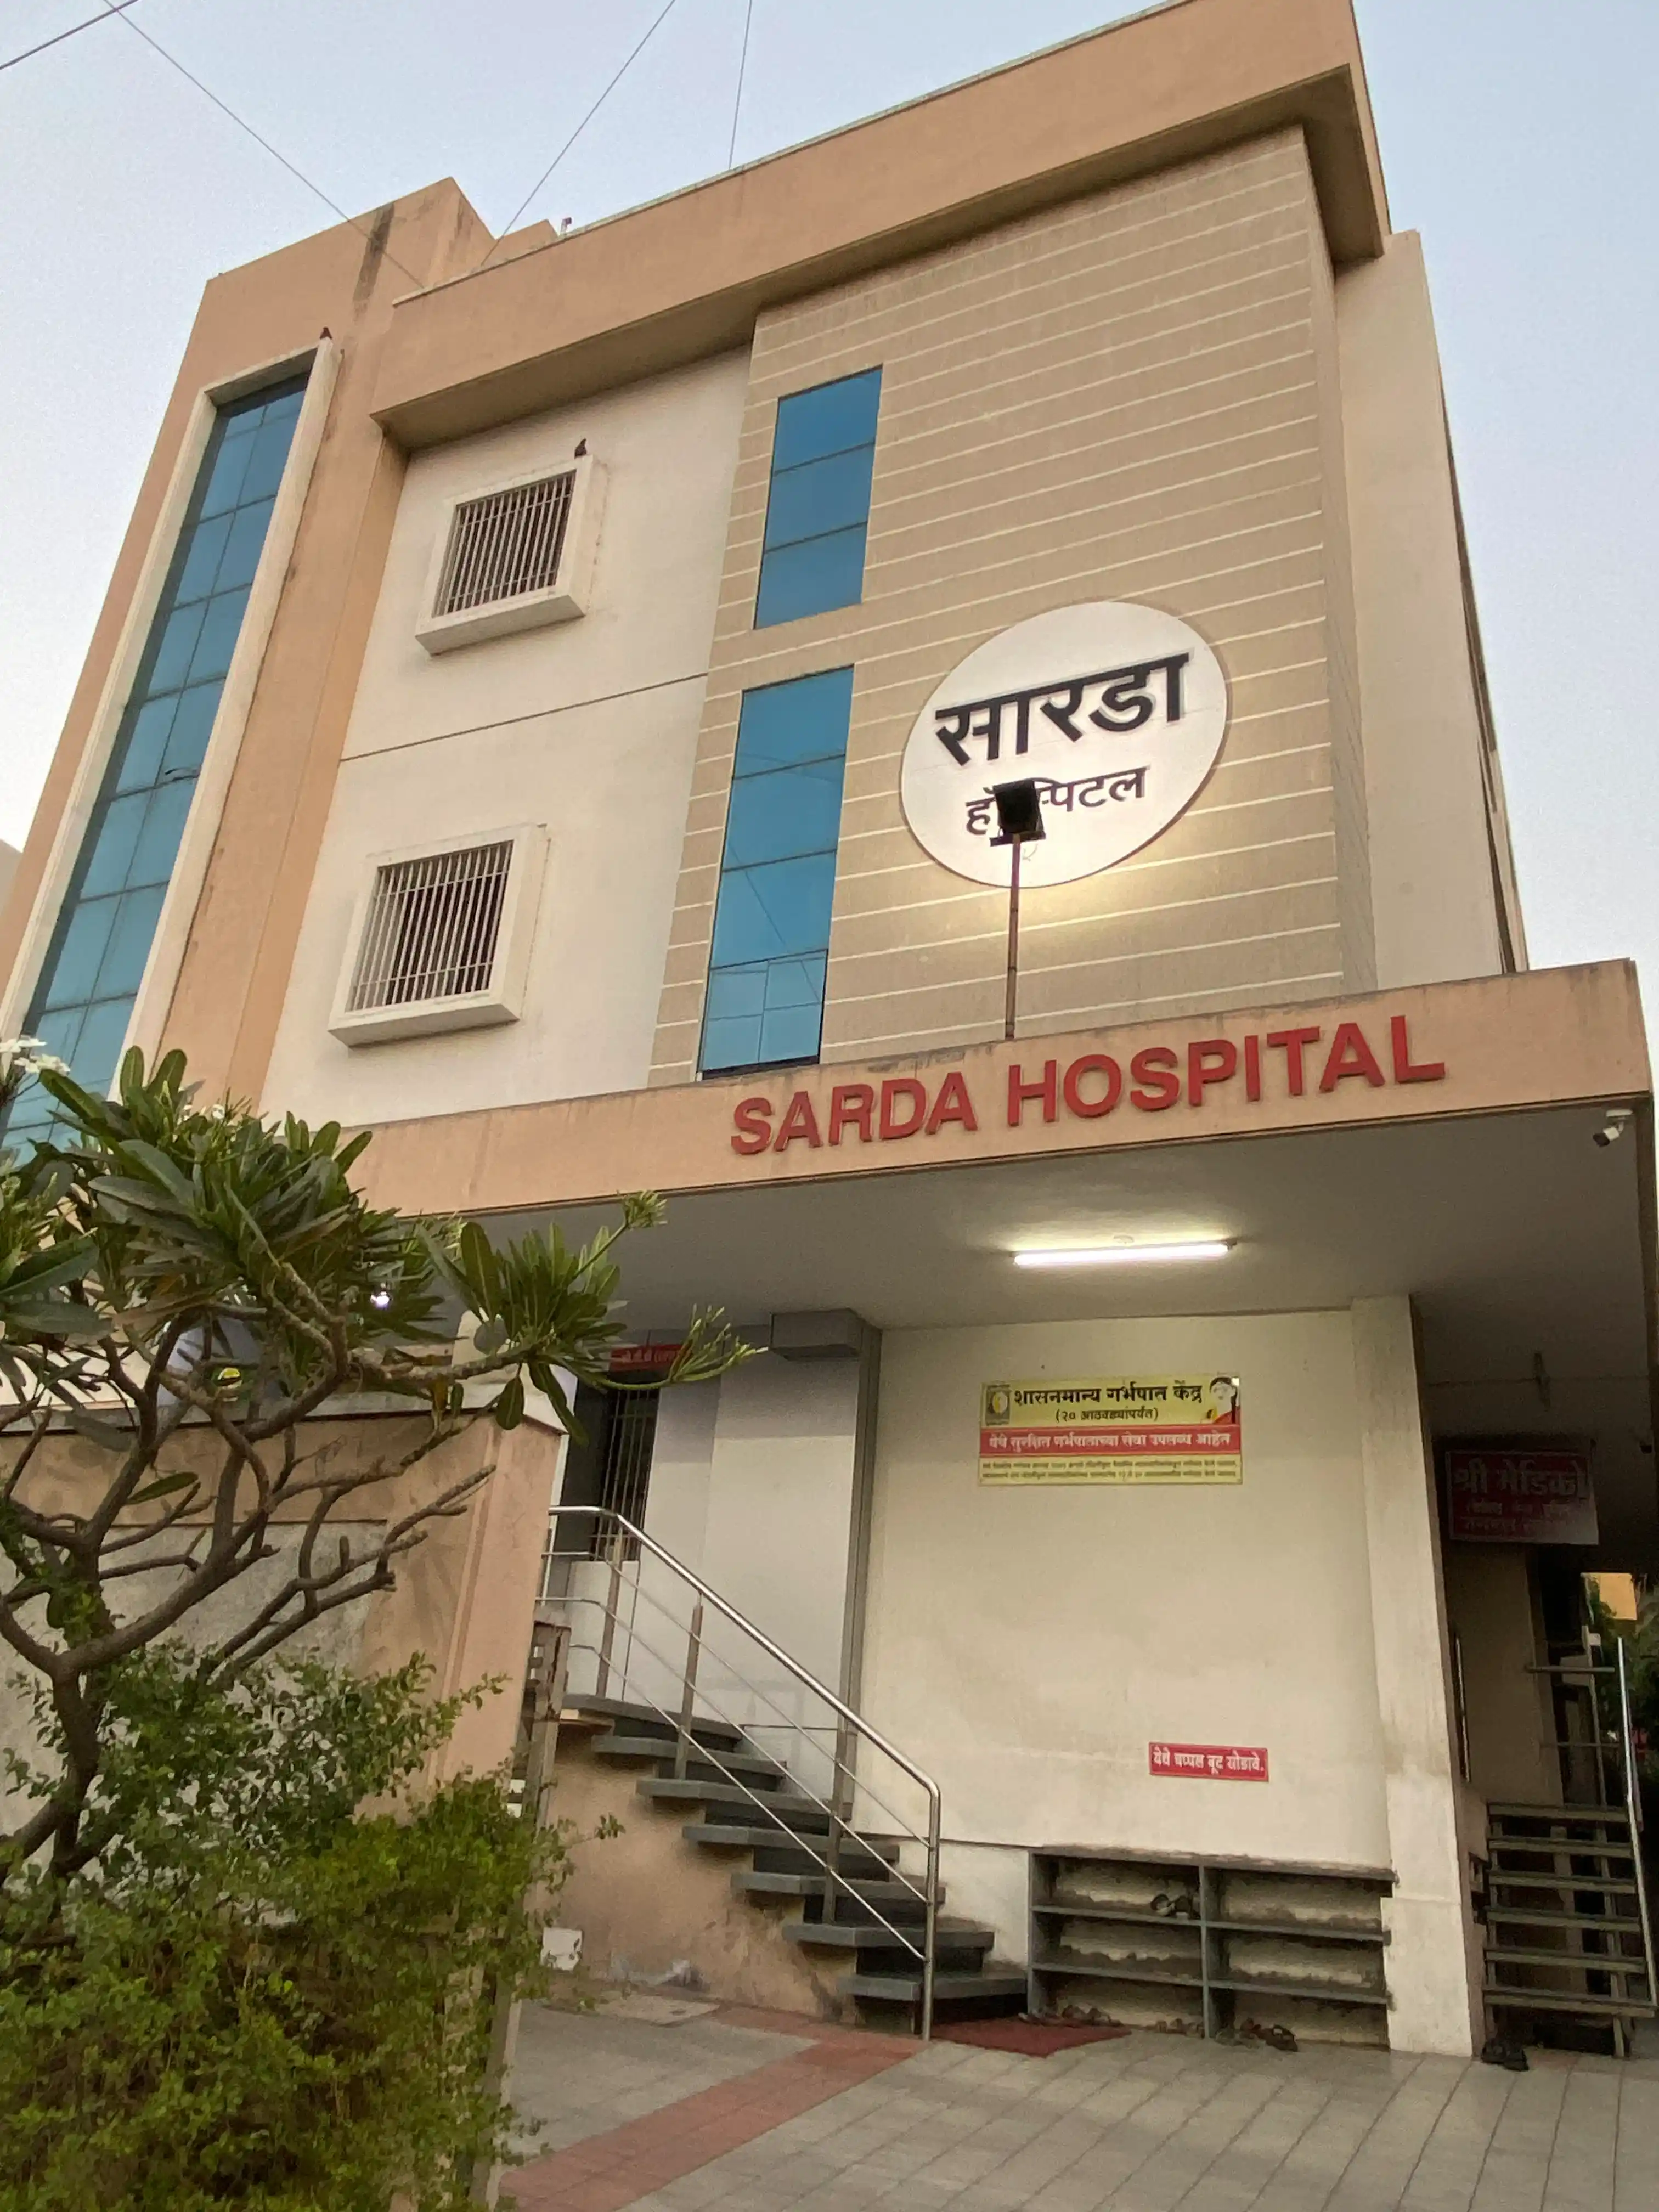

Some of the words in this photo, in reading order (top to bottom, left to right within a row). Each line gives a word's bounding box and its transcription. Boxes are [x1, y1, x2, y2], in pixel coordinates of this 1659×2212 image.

[934, 651, 1192, 766] सारडा
[965, 766, 1148, 836] हॉपिटल
[730, 1071, 978, 1155] SARDA
[1007, 1015, 1446, 1126] HOSPITAL
[1014, 1388, 1101, 1406] शासनमान्य
[1106, 1381, 1167, 1402] गर्भपात
[1055, 1408, 1076, 1423] (२०
